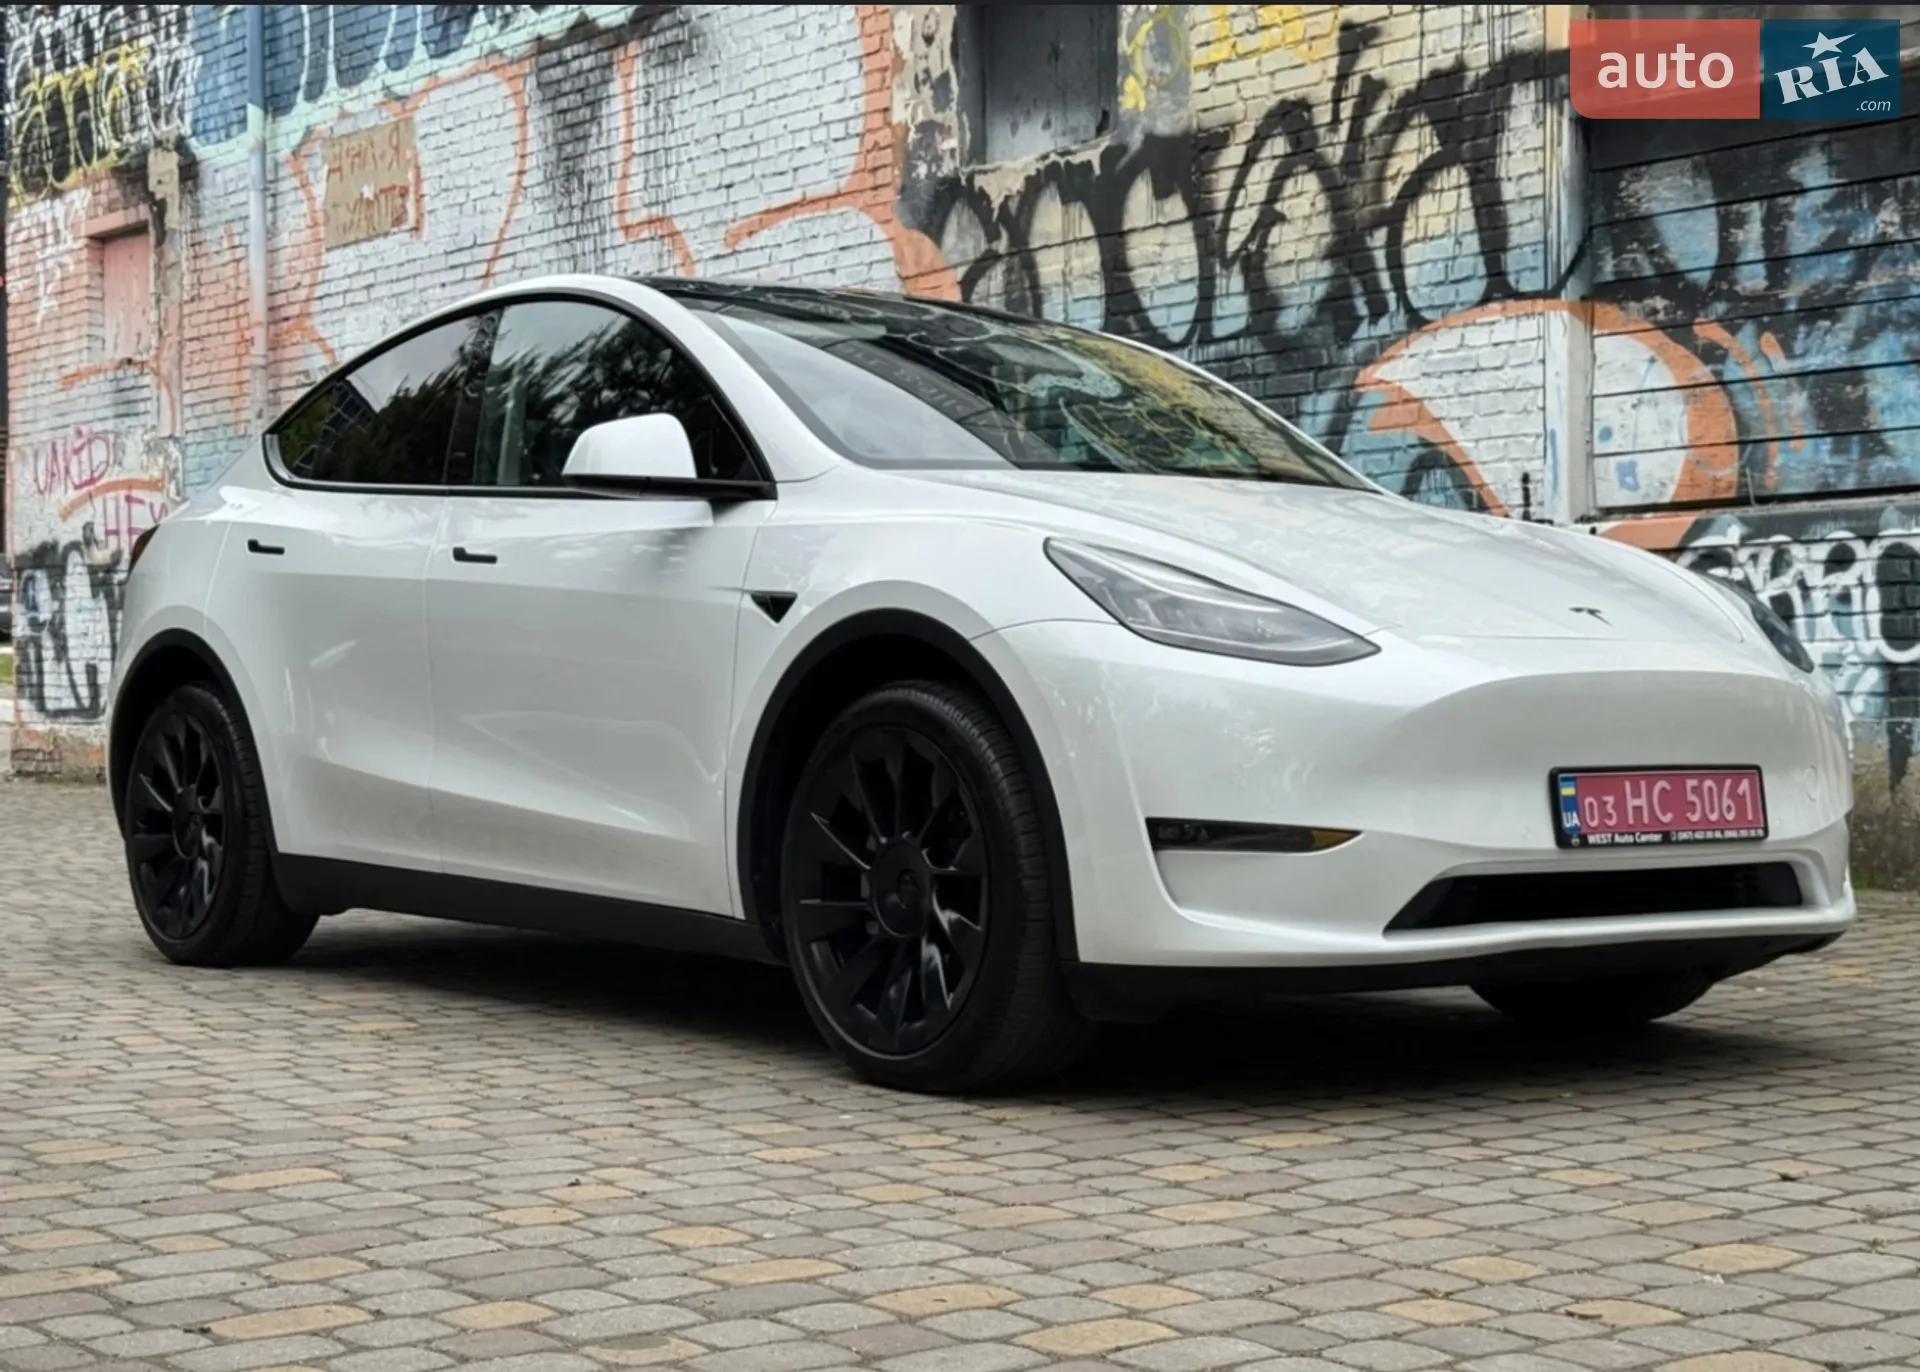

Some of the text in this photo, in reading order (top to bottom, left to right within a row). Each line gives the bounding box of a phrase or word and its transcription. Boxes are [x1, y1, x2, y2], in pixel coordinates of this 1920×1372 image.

[1584, 777, 1753, 828] 03 HC 5061
[1563, 812, 1581, 828] UA
[1587, 833, 1612, 844] WEST
[1614, 832, 1634, 843] Auto
[1635, 831, 1663, 843] Center
